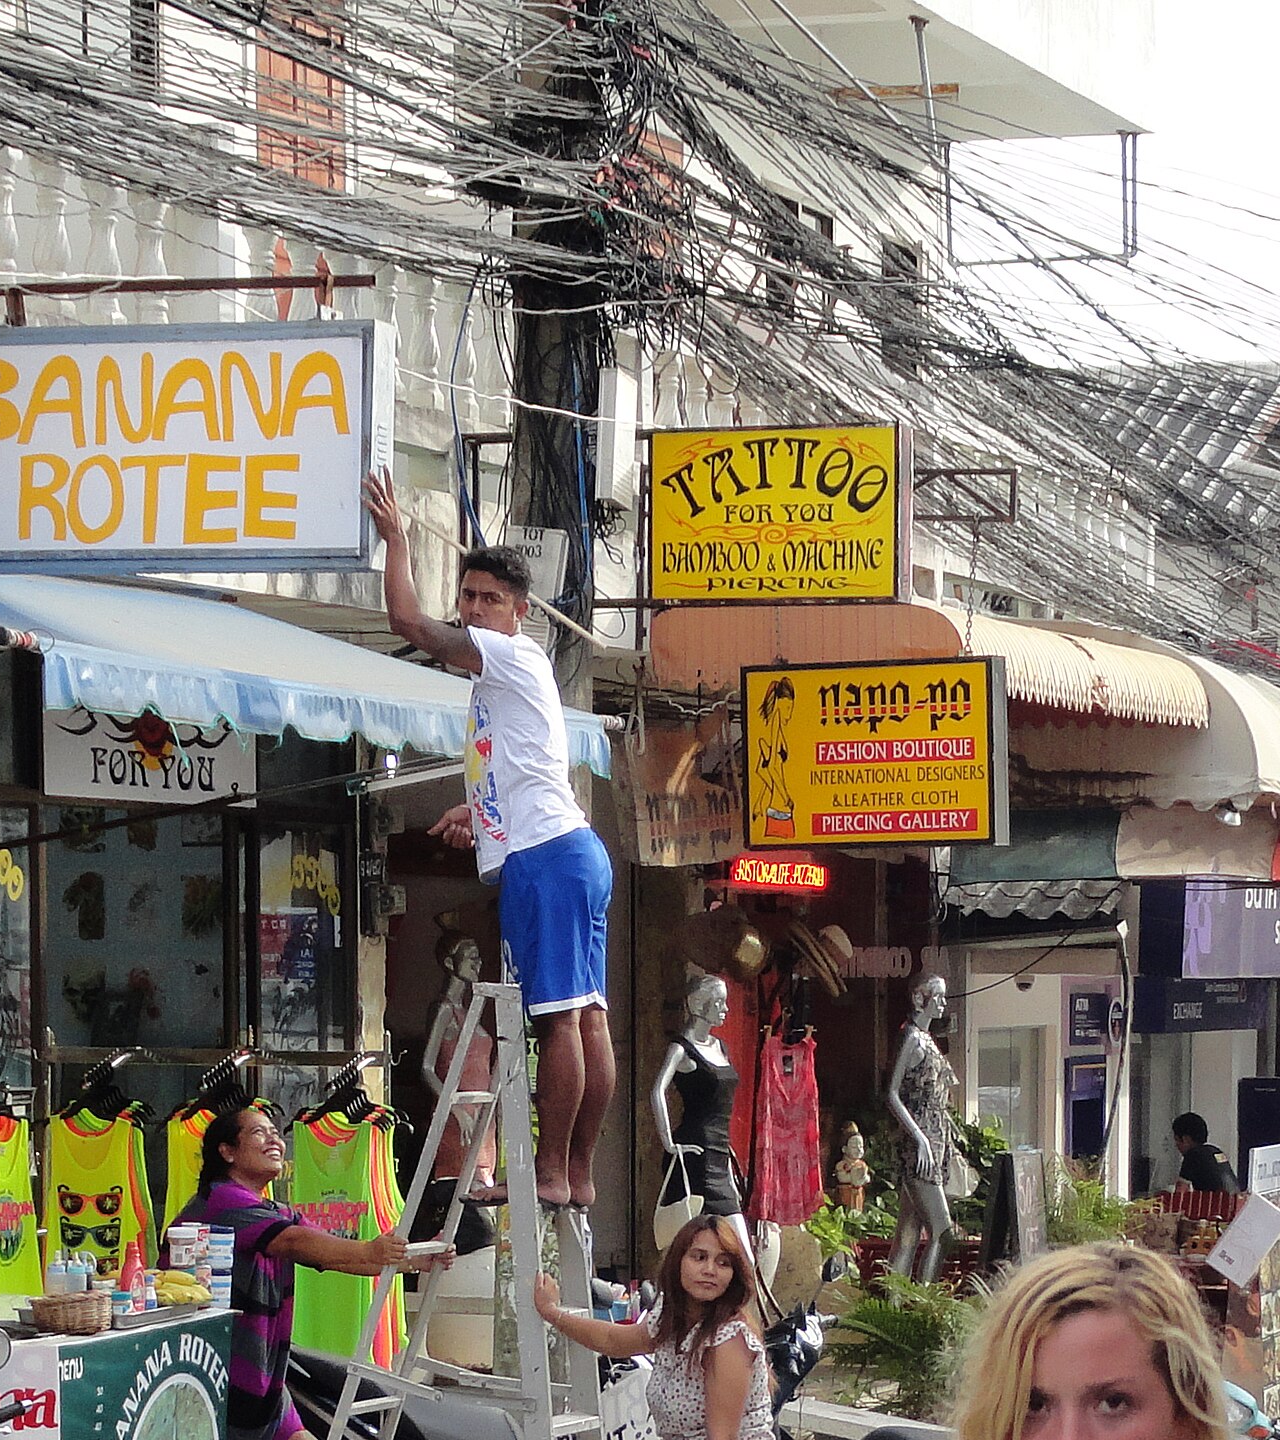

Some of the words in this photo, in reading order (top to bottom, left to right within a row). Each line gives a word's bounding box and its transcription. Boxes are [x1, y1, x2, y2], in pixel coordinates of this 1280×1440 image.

[662, 437, 889, 518] TATTOO
[19, 453, 301, 545] ROTEE
[723, 503, 774, 524] FOR
[781, 503, 834, 524] YOU
[662, 541, 760, 575] BAMBOO
[766, 552, 777, 573] &
[782, 539, 885, 575] MACHINE
[707, 576, 850, 592] PIERCING
[818, 678, 973, 735] napo-po
[818, 742, 888, 762] FASHION
[891, 741, 973, 761] BOUTIQUE
[91, 748, 149, 787] FOR
[158, 756, 216, 792] YOU
[809, 766, 912, 786] INTERNATIONAL
[917, 764, 985, 783] DESIGNERS
[911, 790, 960, 806] CLOTH
[821, 815, 893, 832] PIERCING
[898, 811, 970, 830] GALLERY
[179, 1332, 229, 1401] ROTEE
